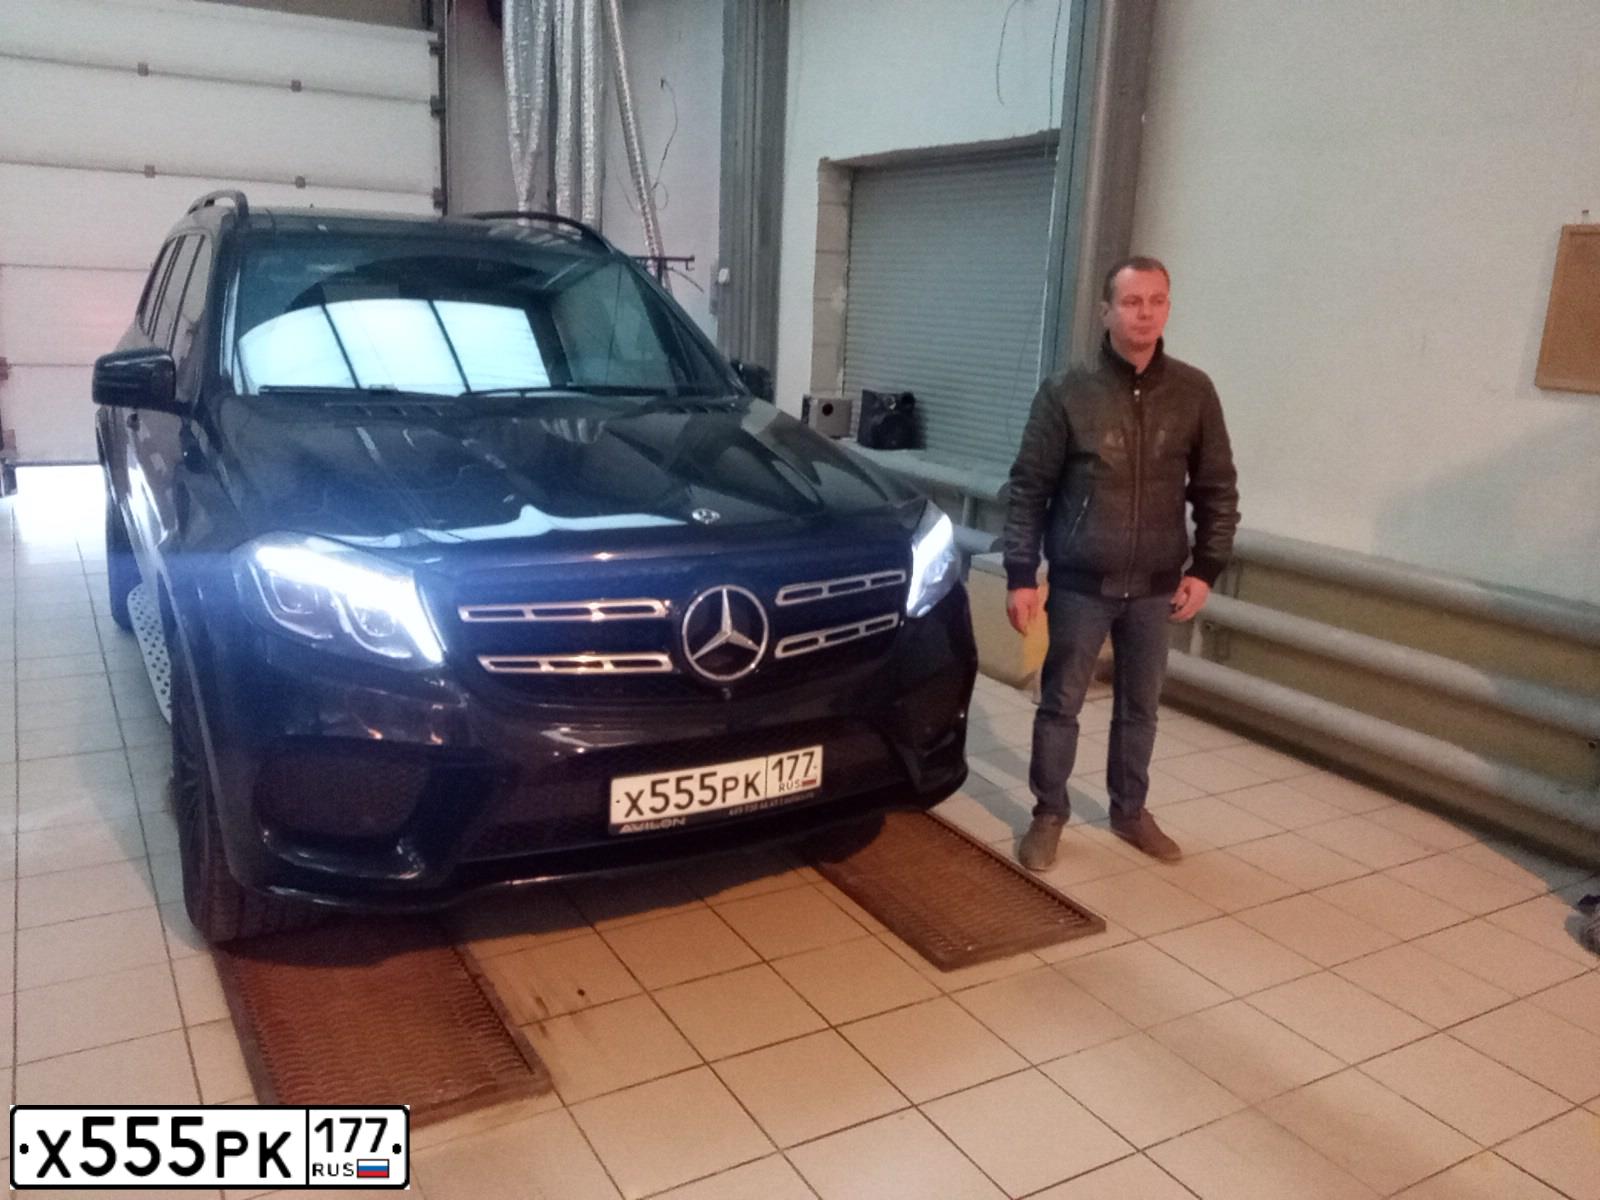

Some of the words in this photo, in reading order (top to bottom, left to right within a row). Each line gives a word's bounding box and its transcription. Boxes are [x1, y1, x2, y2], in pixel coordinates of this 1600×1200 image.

[624, 771, 761, 818] X555PK
[771, 751, 815, 782] 177
[778, 780, 801, 793] RUS
[619, 817, 686, 834] AVILON
